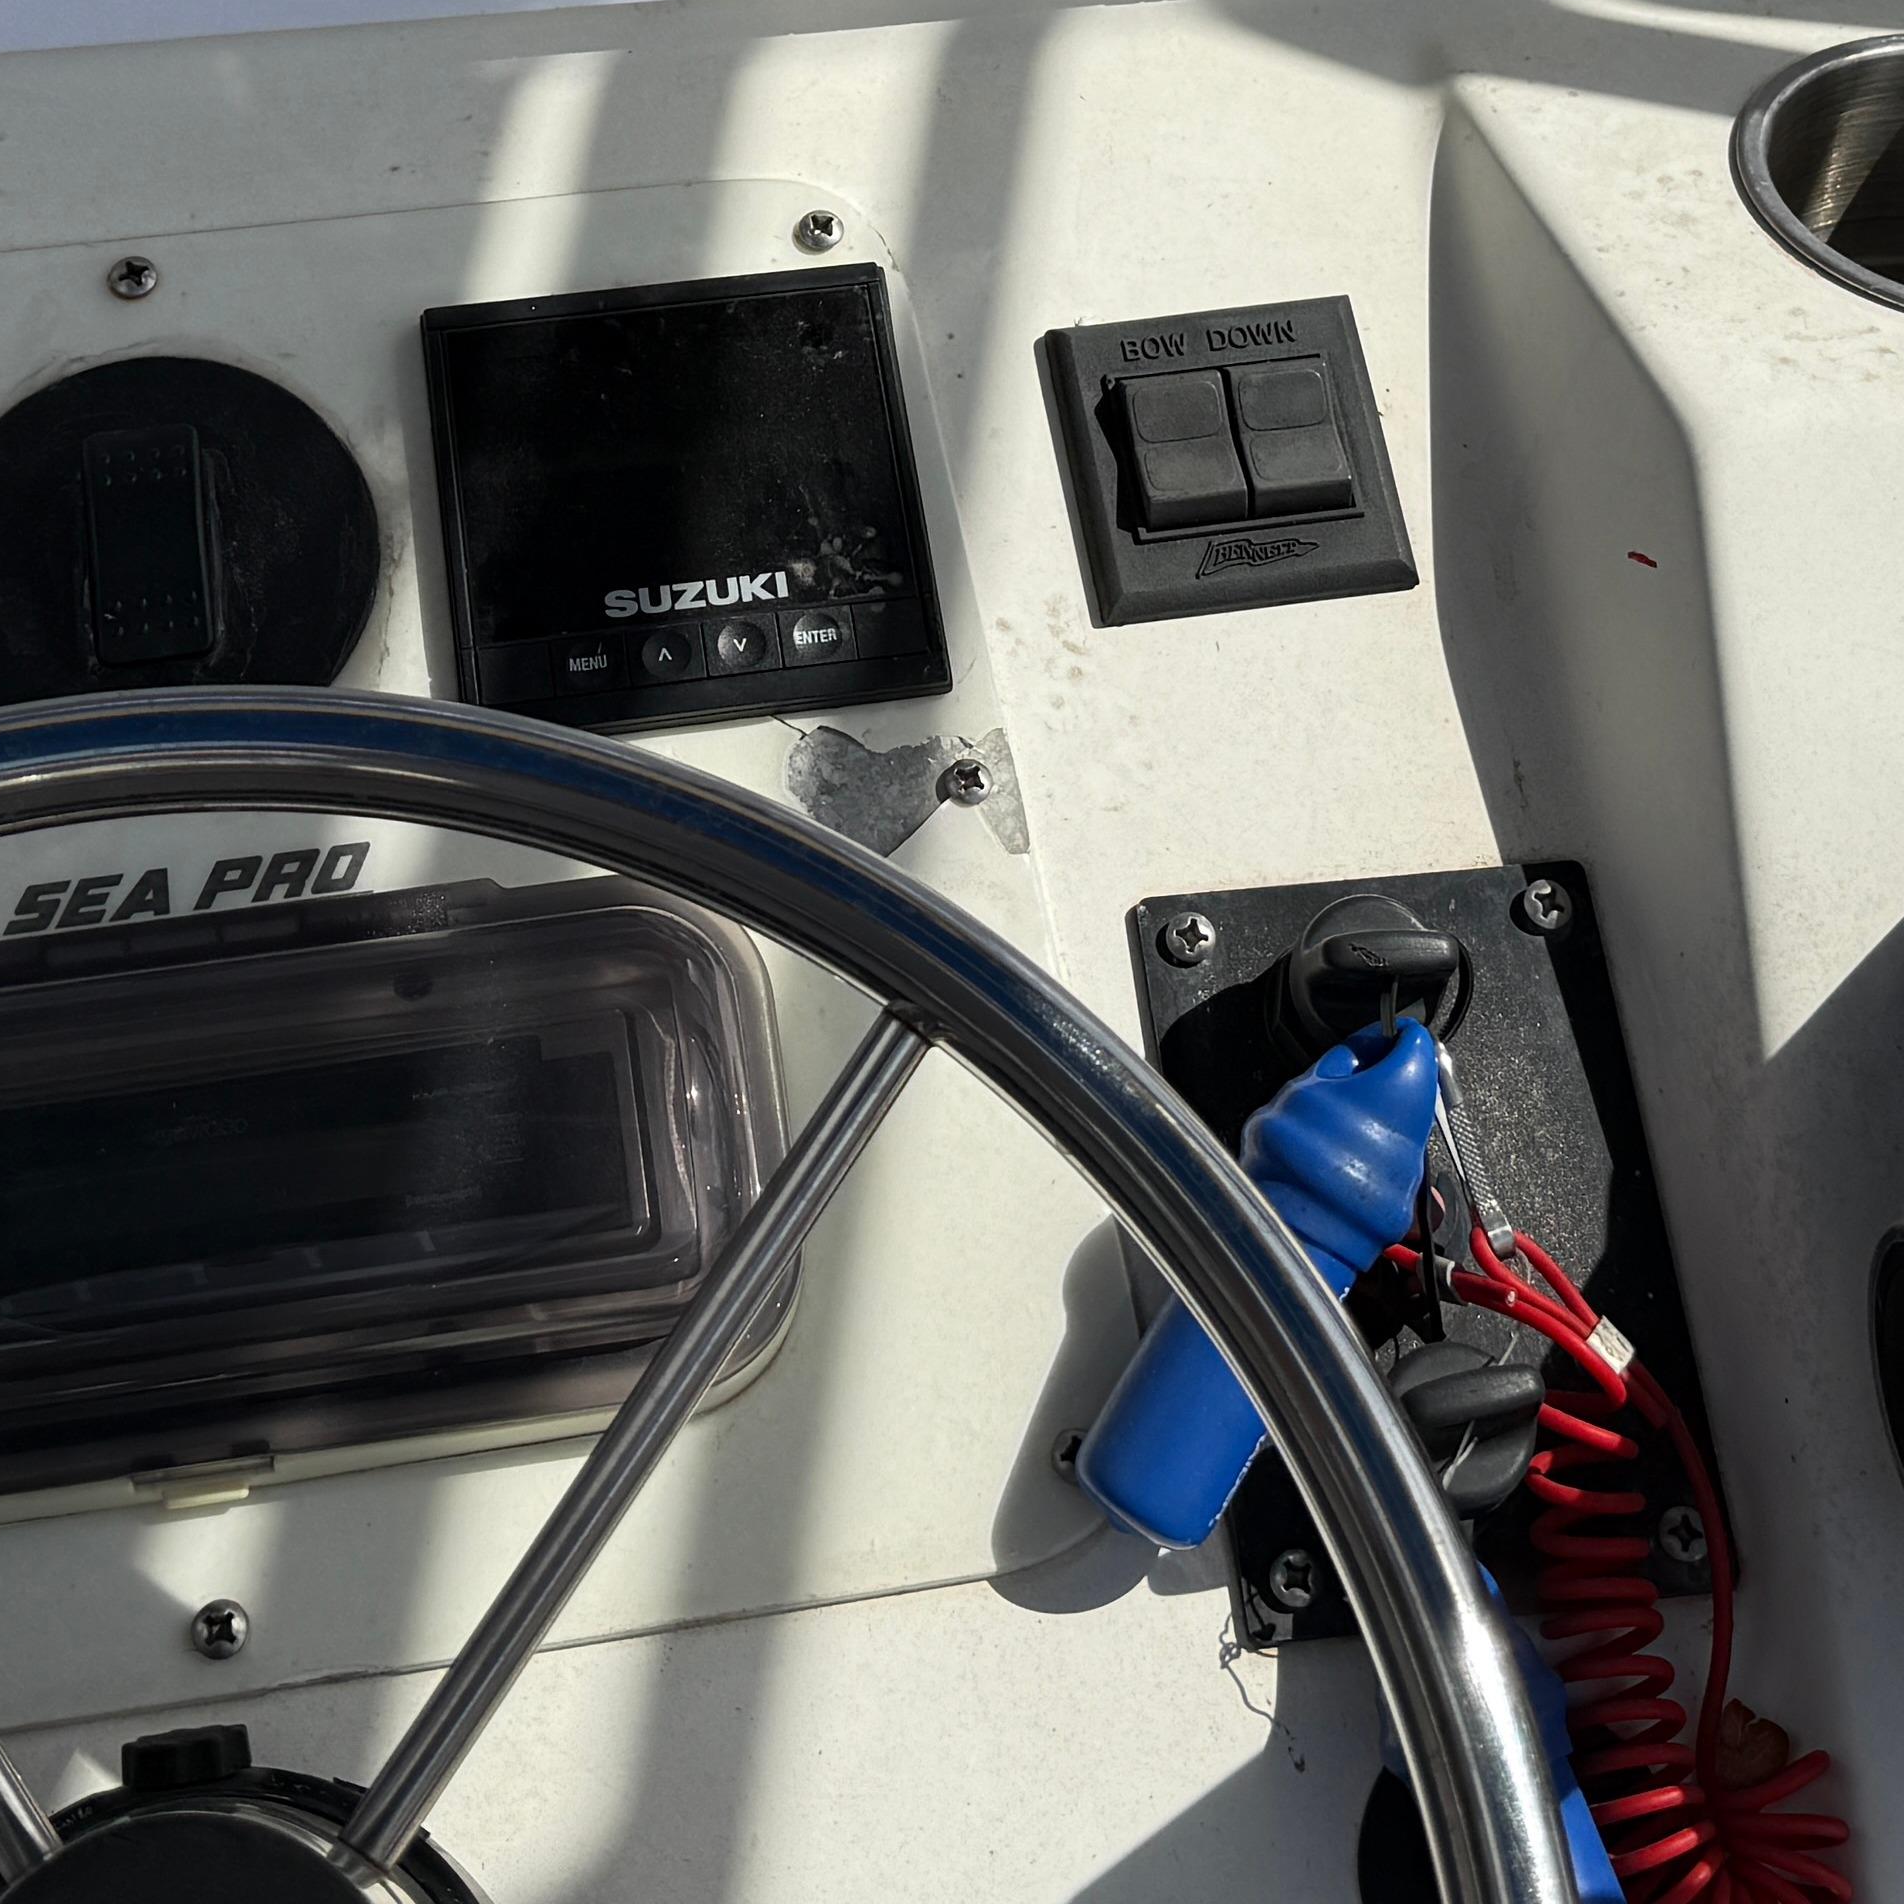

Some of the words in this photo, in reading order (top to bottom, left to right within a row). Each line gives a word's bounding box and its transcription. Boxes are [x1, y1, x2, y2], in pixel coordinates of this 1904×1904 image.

[1120, 331, 1187, 363] BOW
[1205, 319, 1298, 352] DOWN
[604, 571, 789, 618] SUZUKI
[794, 627, 838, 646] ENTER
[569, 653, 608, 673] MENU
[3, 867, 171, 936] SEA
[193, 841, 371, 910] PRO
